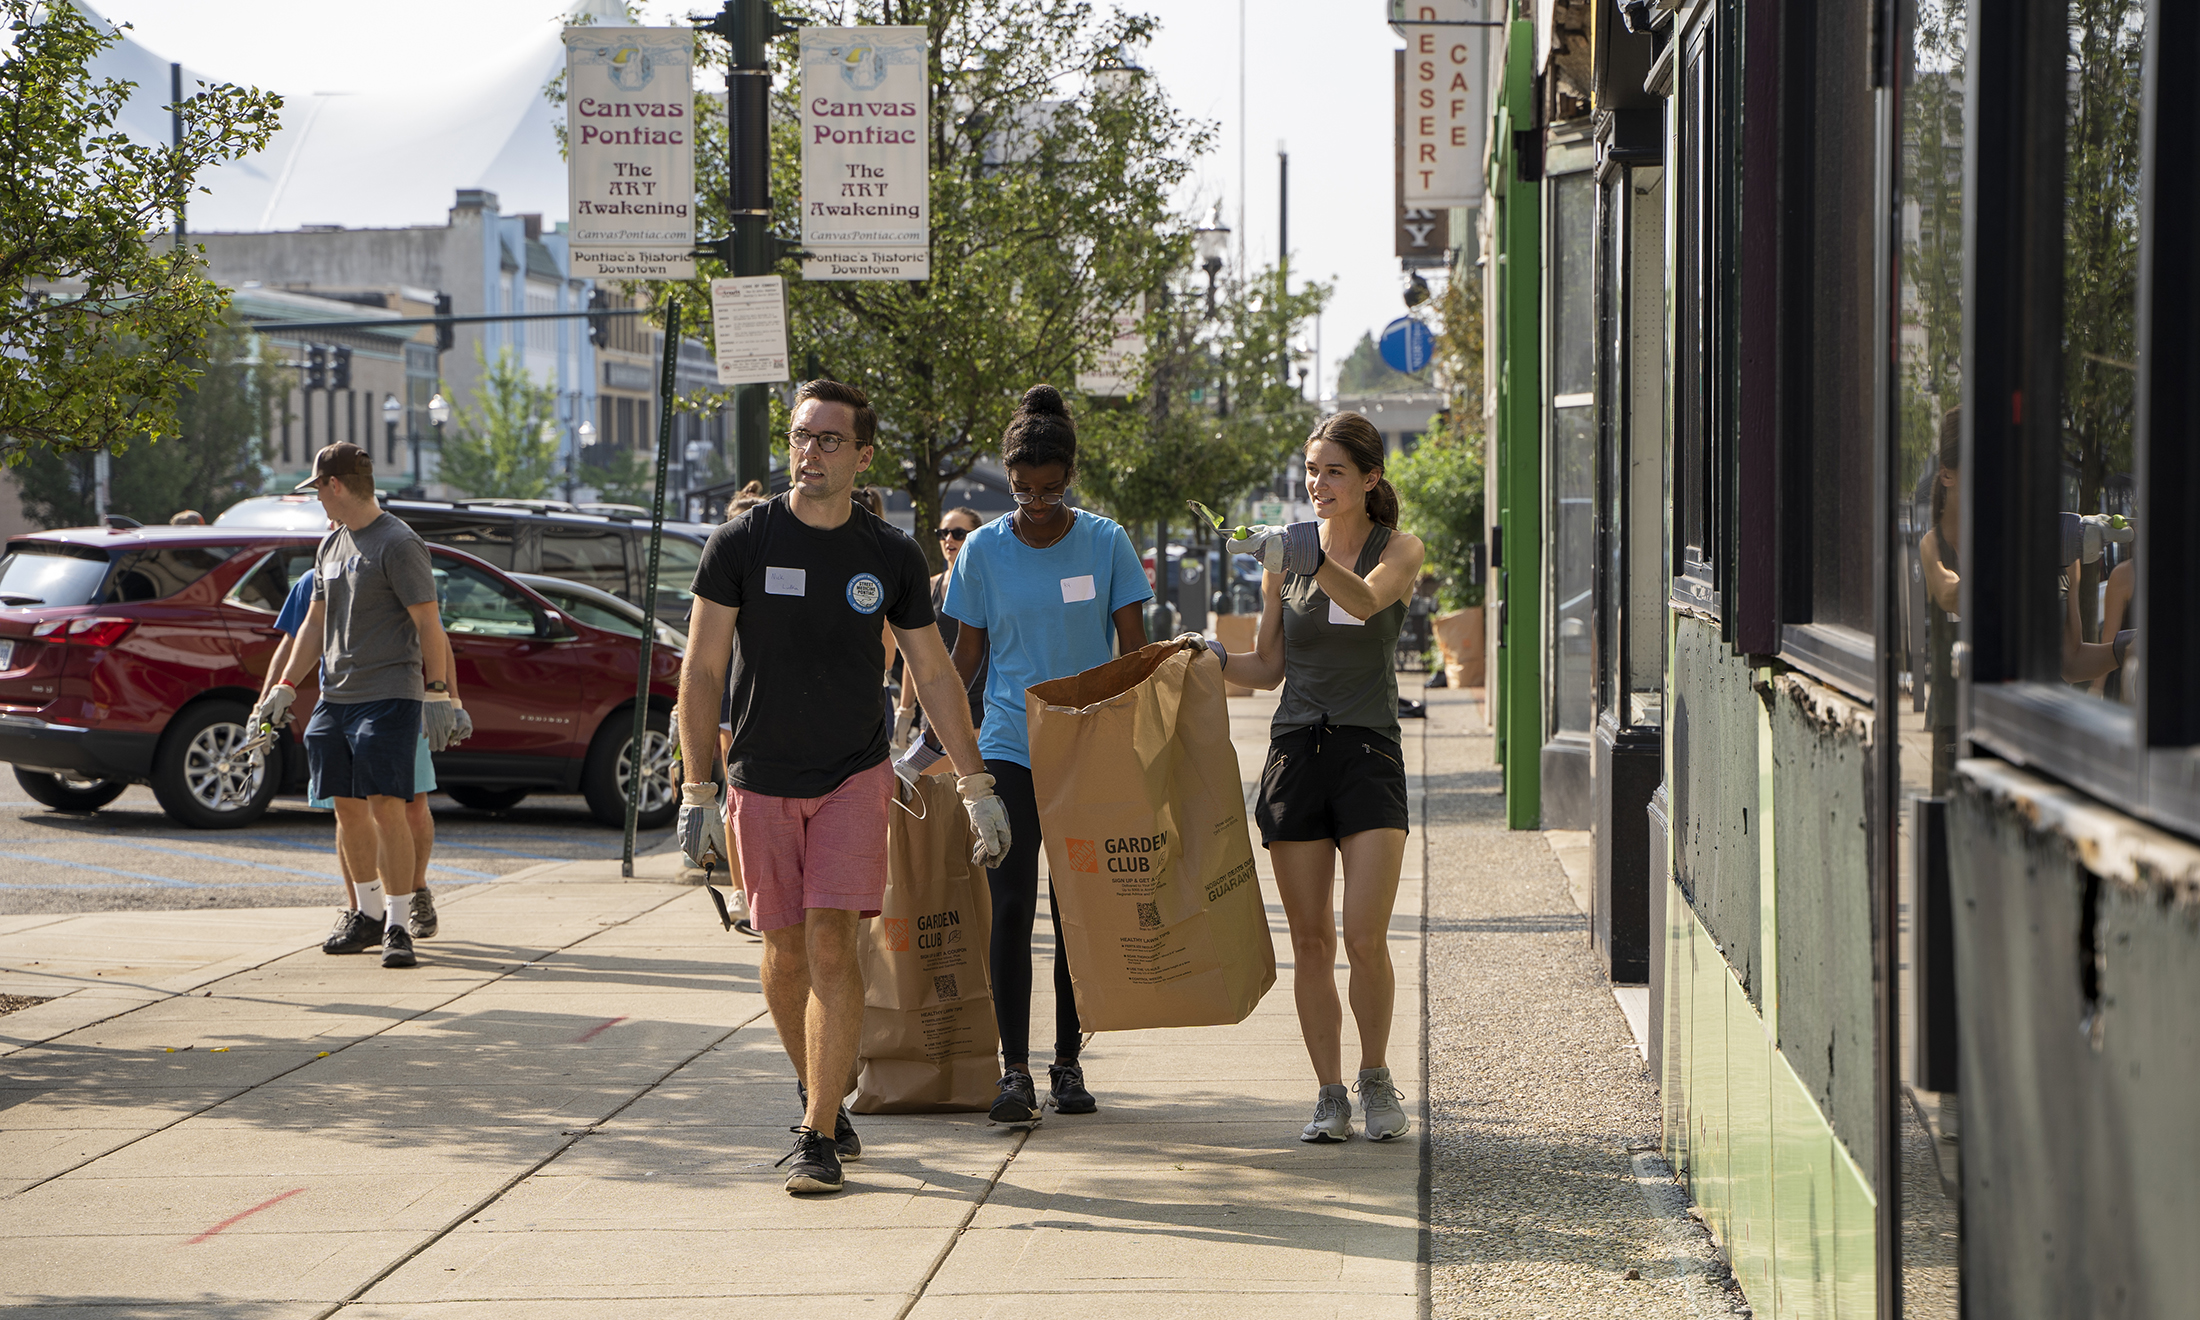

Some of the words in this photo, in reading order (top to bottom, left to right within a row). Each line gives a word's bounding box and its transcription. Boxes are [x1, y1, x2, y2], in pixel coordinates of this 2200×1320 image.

[1419, 6, 1436, 190] DESSERT
[1450, 44, 1468, 146] CAFE
[579, 97, 684, 117] Canvas
[812, 97, 917, 117] Canvas
[580, 125, 684, 145] Pontiac
[813, 125, 916, 144] Pontiac
[613, 162, 653, 177] The
[845, 164, 885, 178] The
[609, 181, 657, 196] ART
[841, 183, 889, 197] ART
[578, 200, 688, 218] Awakening
[810, 202, 920, 219] Awakening
[577, 229, 687, 240] CanvasPontiac.com
[810, 231, 920, 240] CanvasPontiac.com
[574, 251, 636, 262] Pontiac's
[639, 251, 692, 264] Historic
[871, 252, 925, 264] Historic
[598, 264, 667, 274] Downtown
[831, 264, 900, 275] Downtown
[1070, 842, 1080, 854] THE
[1104, 830, 1168, 854] GARDEN
[1070, 840, 1095, 871] HOME
[1080, 853, 1097, 872] DEPOT
[1107, 856, 1150, 873] CLUB
[1204, 874, 1227, 892] NOBODY
[1227, 864, 1244, 878] BEATS
[918, 910, 960, 930] GARDEN
[918, 932, 942, 949] CLUB
[1160, 930, 1170, 938] TIPS
